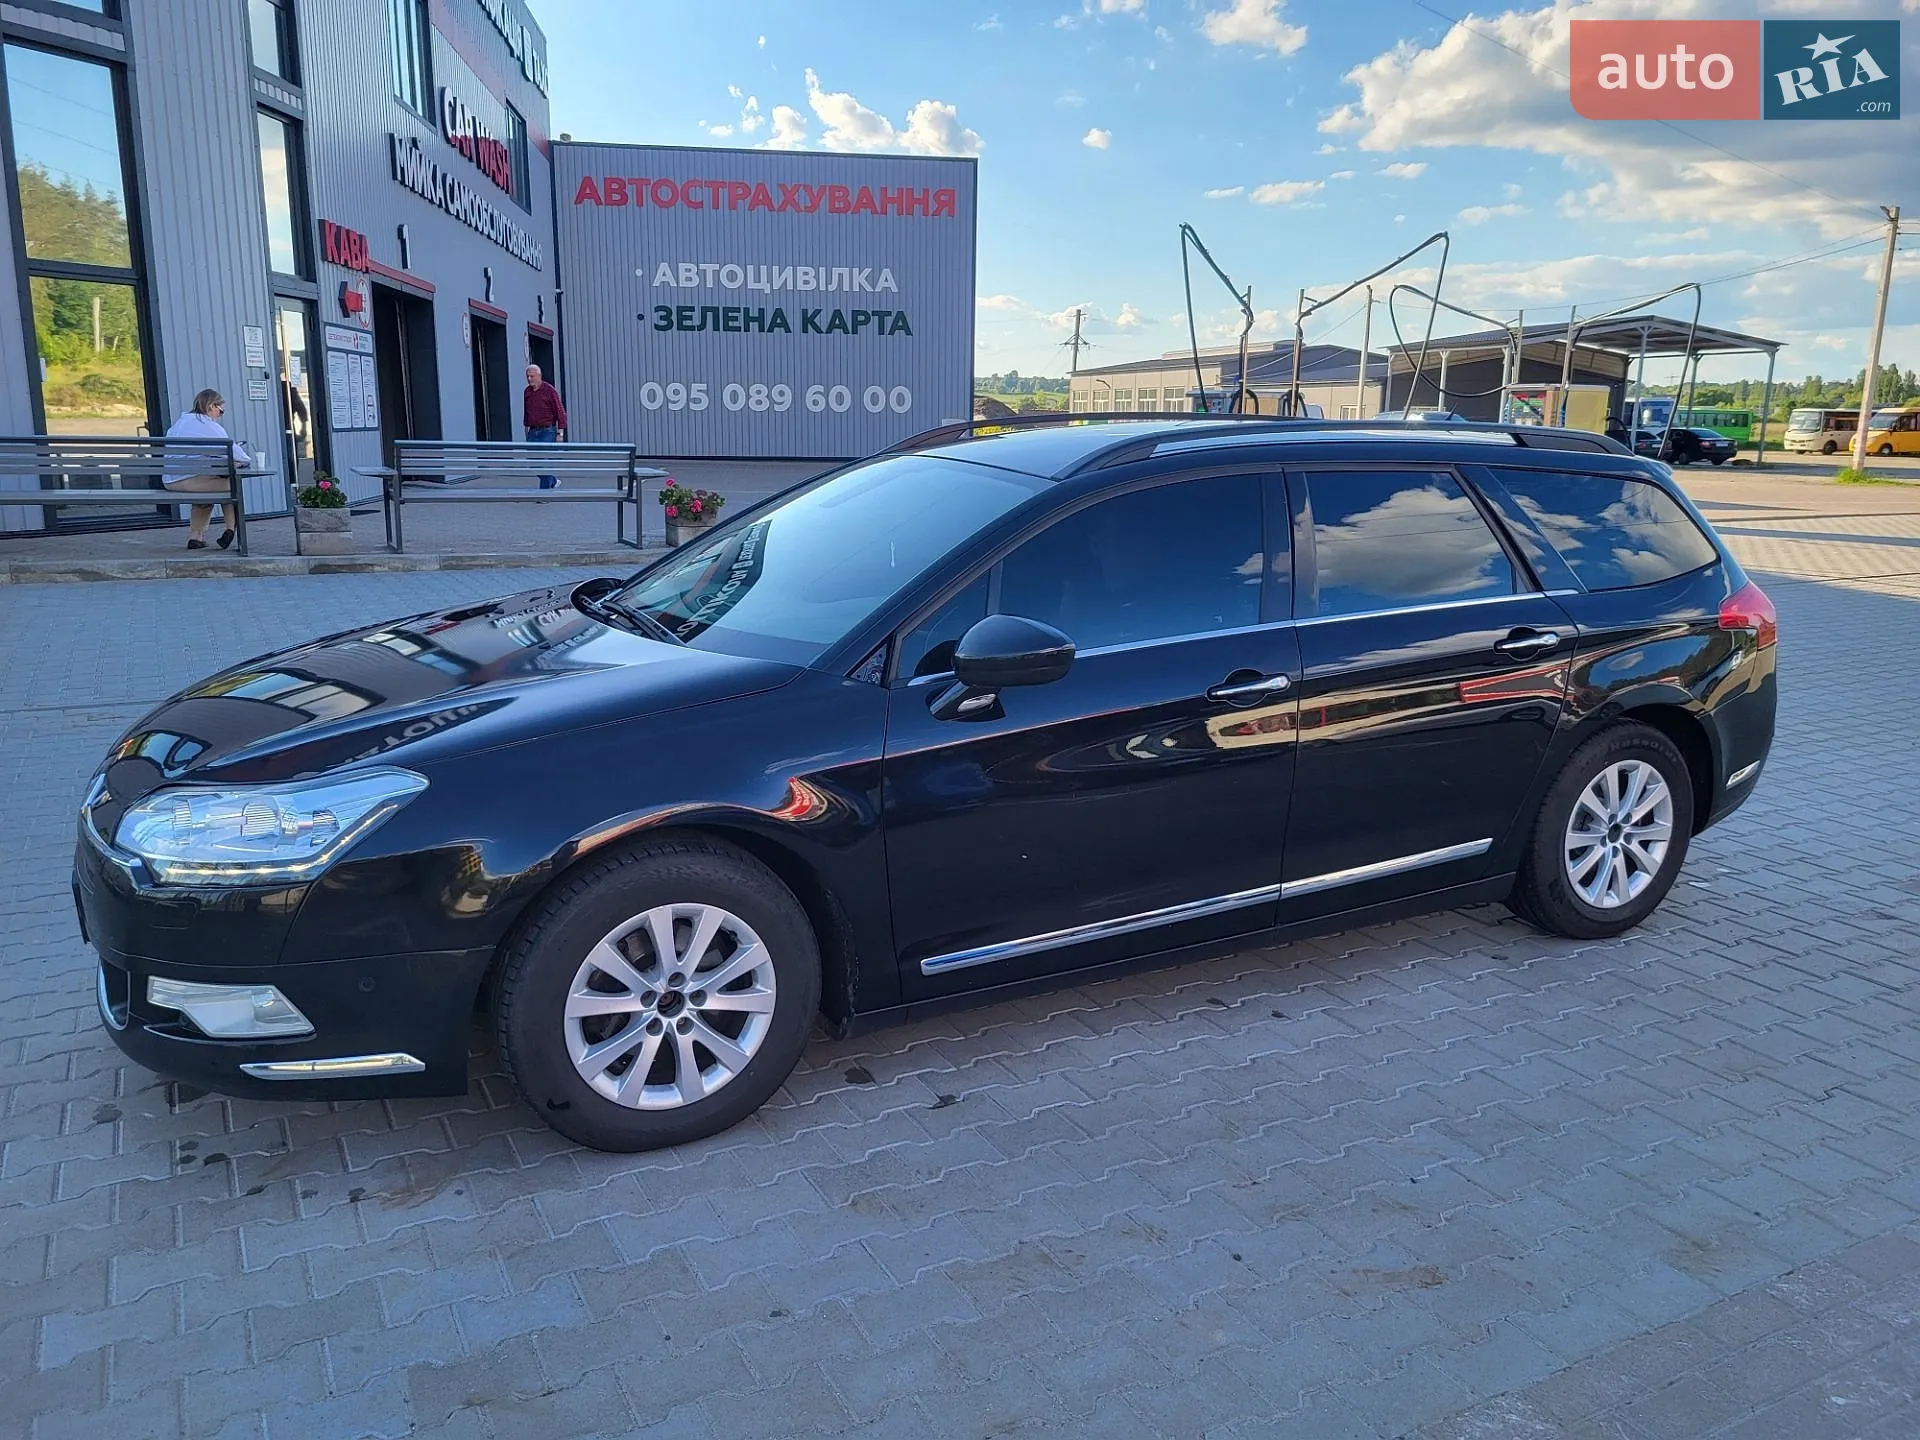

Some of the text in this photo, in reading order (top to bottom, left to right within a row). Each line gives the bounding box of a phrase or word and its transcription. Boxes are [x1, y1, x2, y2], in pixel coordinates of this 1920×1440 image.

[441, 86, 513, 196] CAR WASH
[575, 176, 956, 217] АВТОСТРАХУВАННЯ
[321, 219, 370, 273] КАВА
[397, 223, 411, 269] 1
[652, 262, 898, 294] АВТОЦИВІЛКА
[653, 305, 913, 336] ЗЕЛЕНА КАРТА
[640, 381, 912, 414] 095 089 60 00
